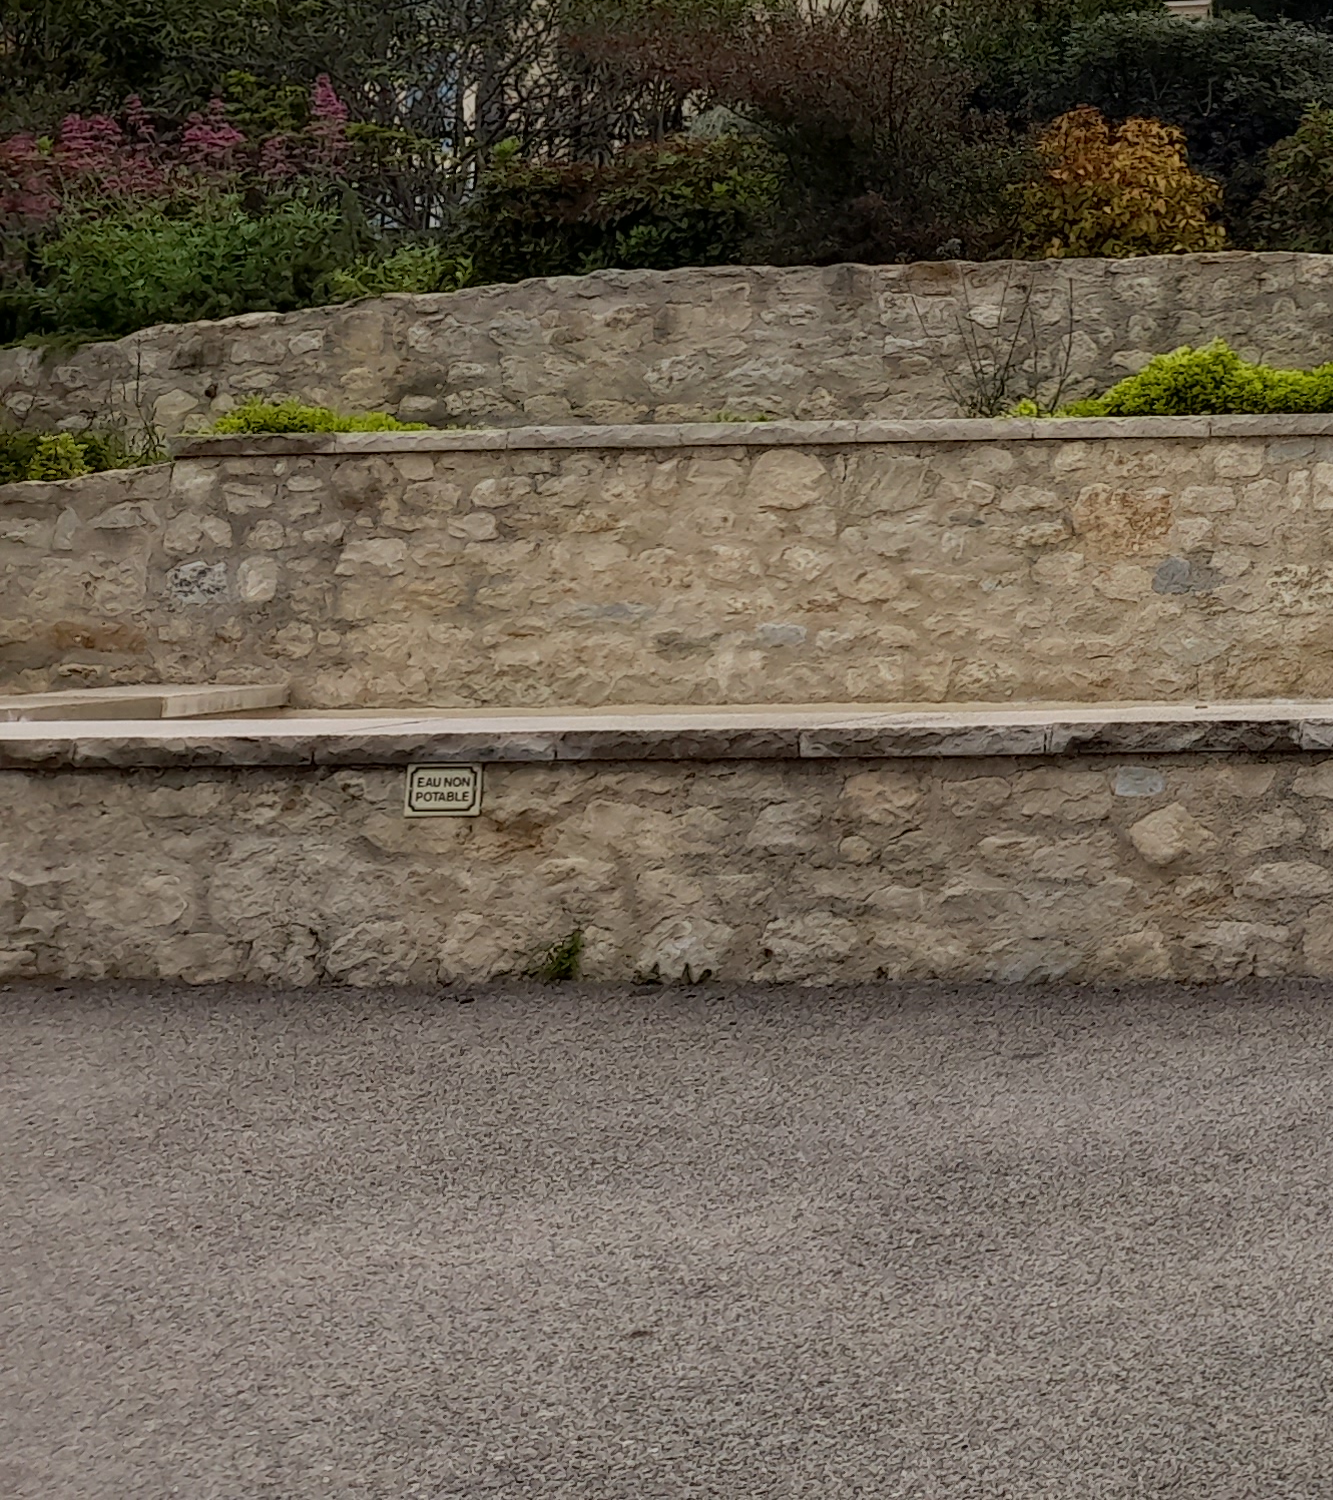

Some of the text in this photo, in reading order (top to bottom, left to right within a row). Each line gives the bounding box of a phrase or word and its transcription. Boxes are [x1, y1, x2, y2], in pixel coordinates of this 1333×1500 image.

[417, 776, 471, 788] EAU NON
[415, 791, 469, 802] POTABLE
